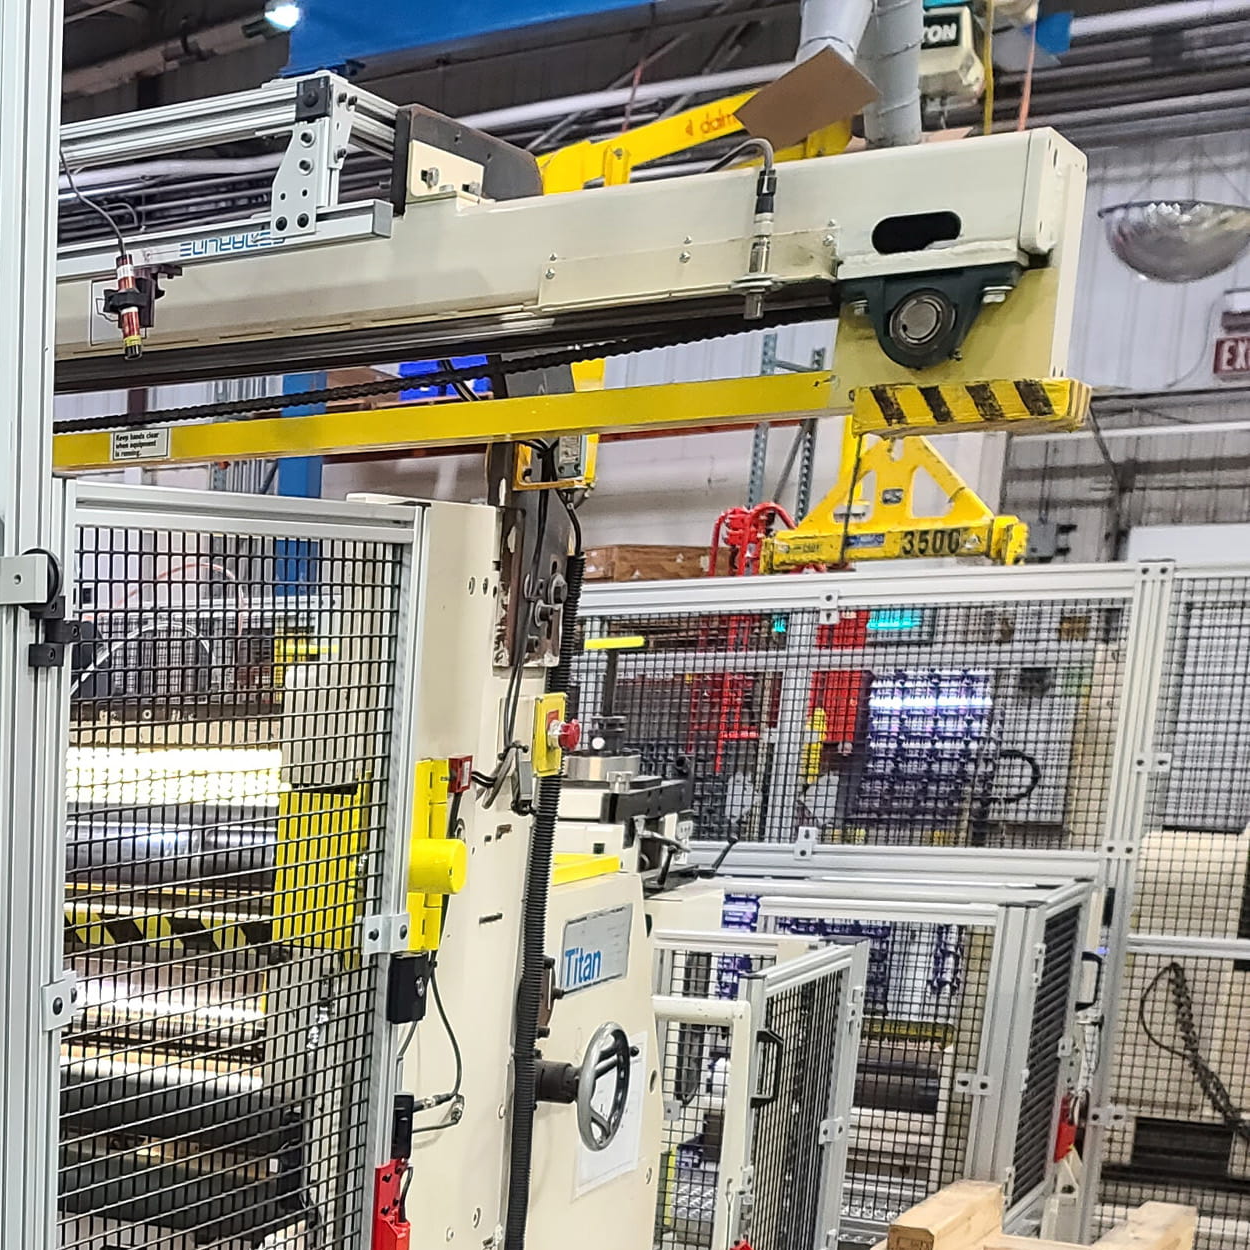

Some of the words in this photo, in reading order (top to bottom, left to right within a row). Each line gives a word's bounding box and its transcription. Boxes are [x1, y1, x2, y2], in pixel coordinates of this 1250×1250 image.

[1222, 340, 1250, 371] EX
[901, 529, 961, 555] 3500
[564, 947, 603, 986] Titan
